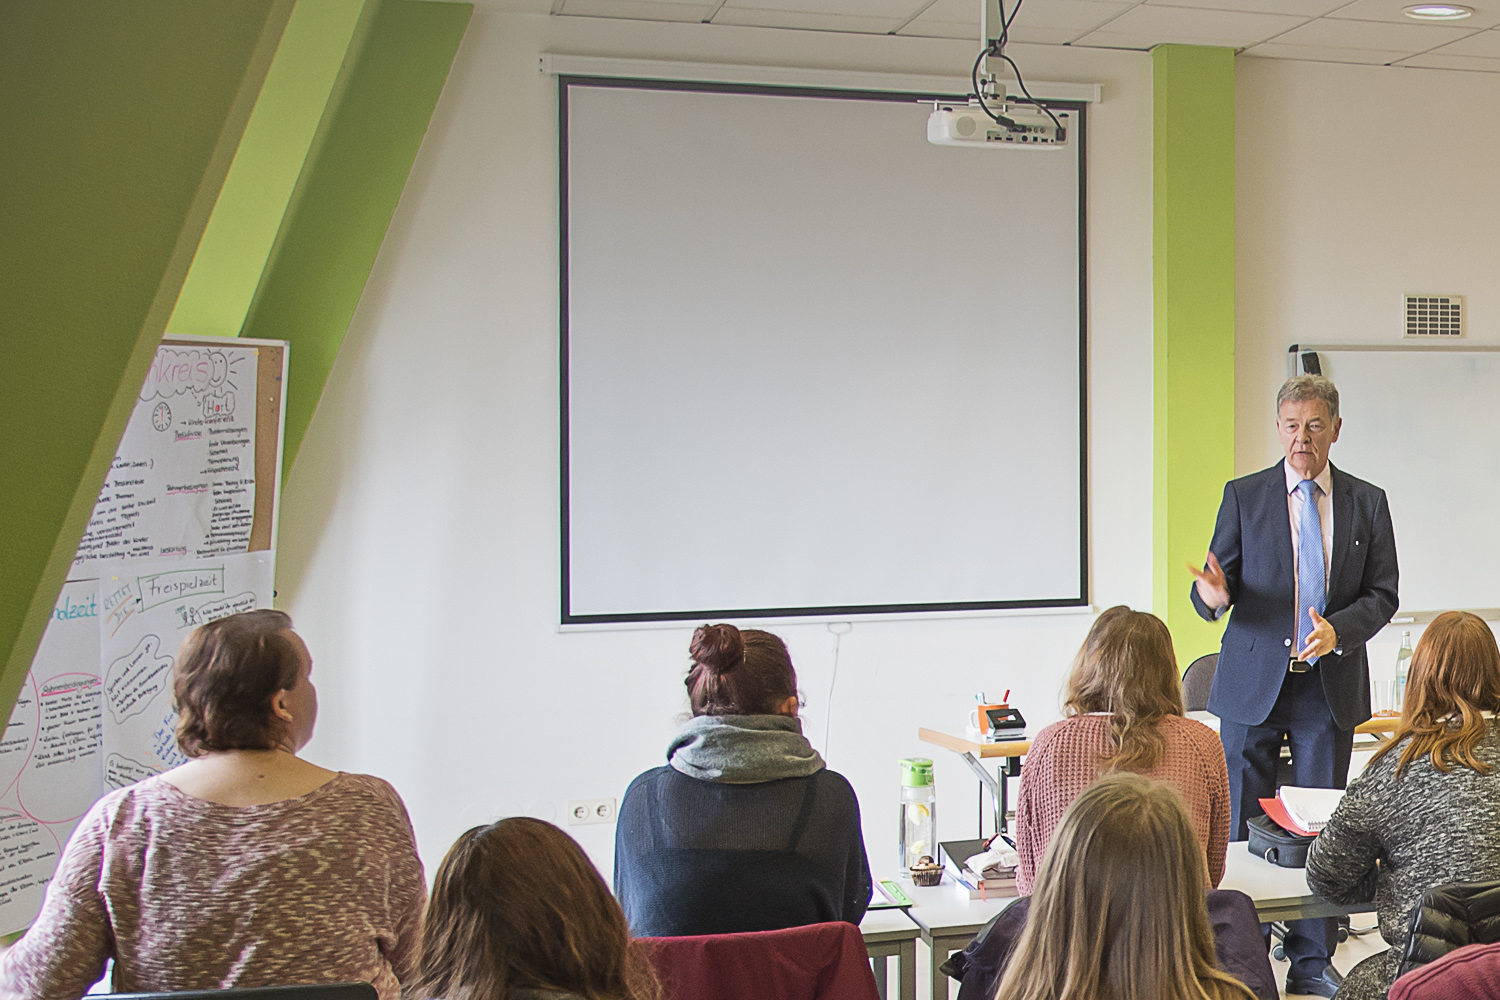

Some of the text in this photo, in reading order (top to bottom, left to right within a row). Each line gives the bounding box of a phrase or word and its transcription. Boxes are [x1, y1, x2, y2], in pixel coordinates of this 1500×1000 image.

[147, 354, 208, 384] nkreis
[207, 396, 230, 413] Hort
[104, 584, 132, 610] RETTET
[146, 575, 217, 596] Freispielzeit
